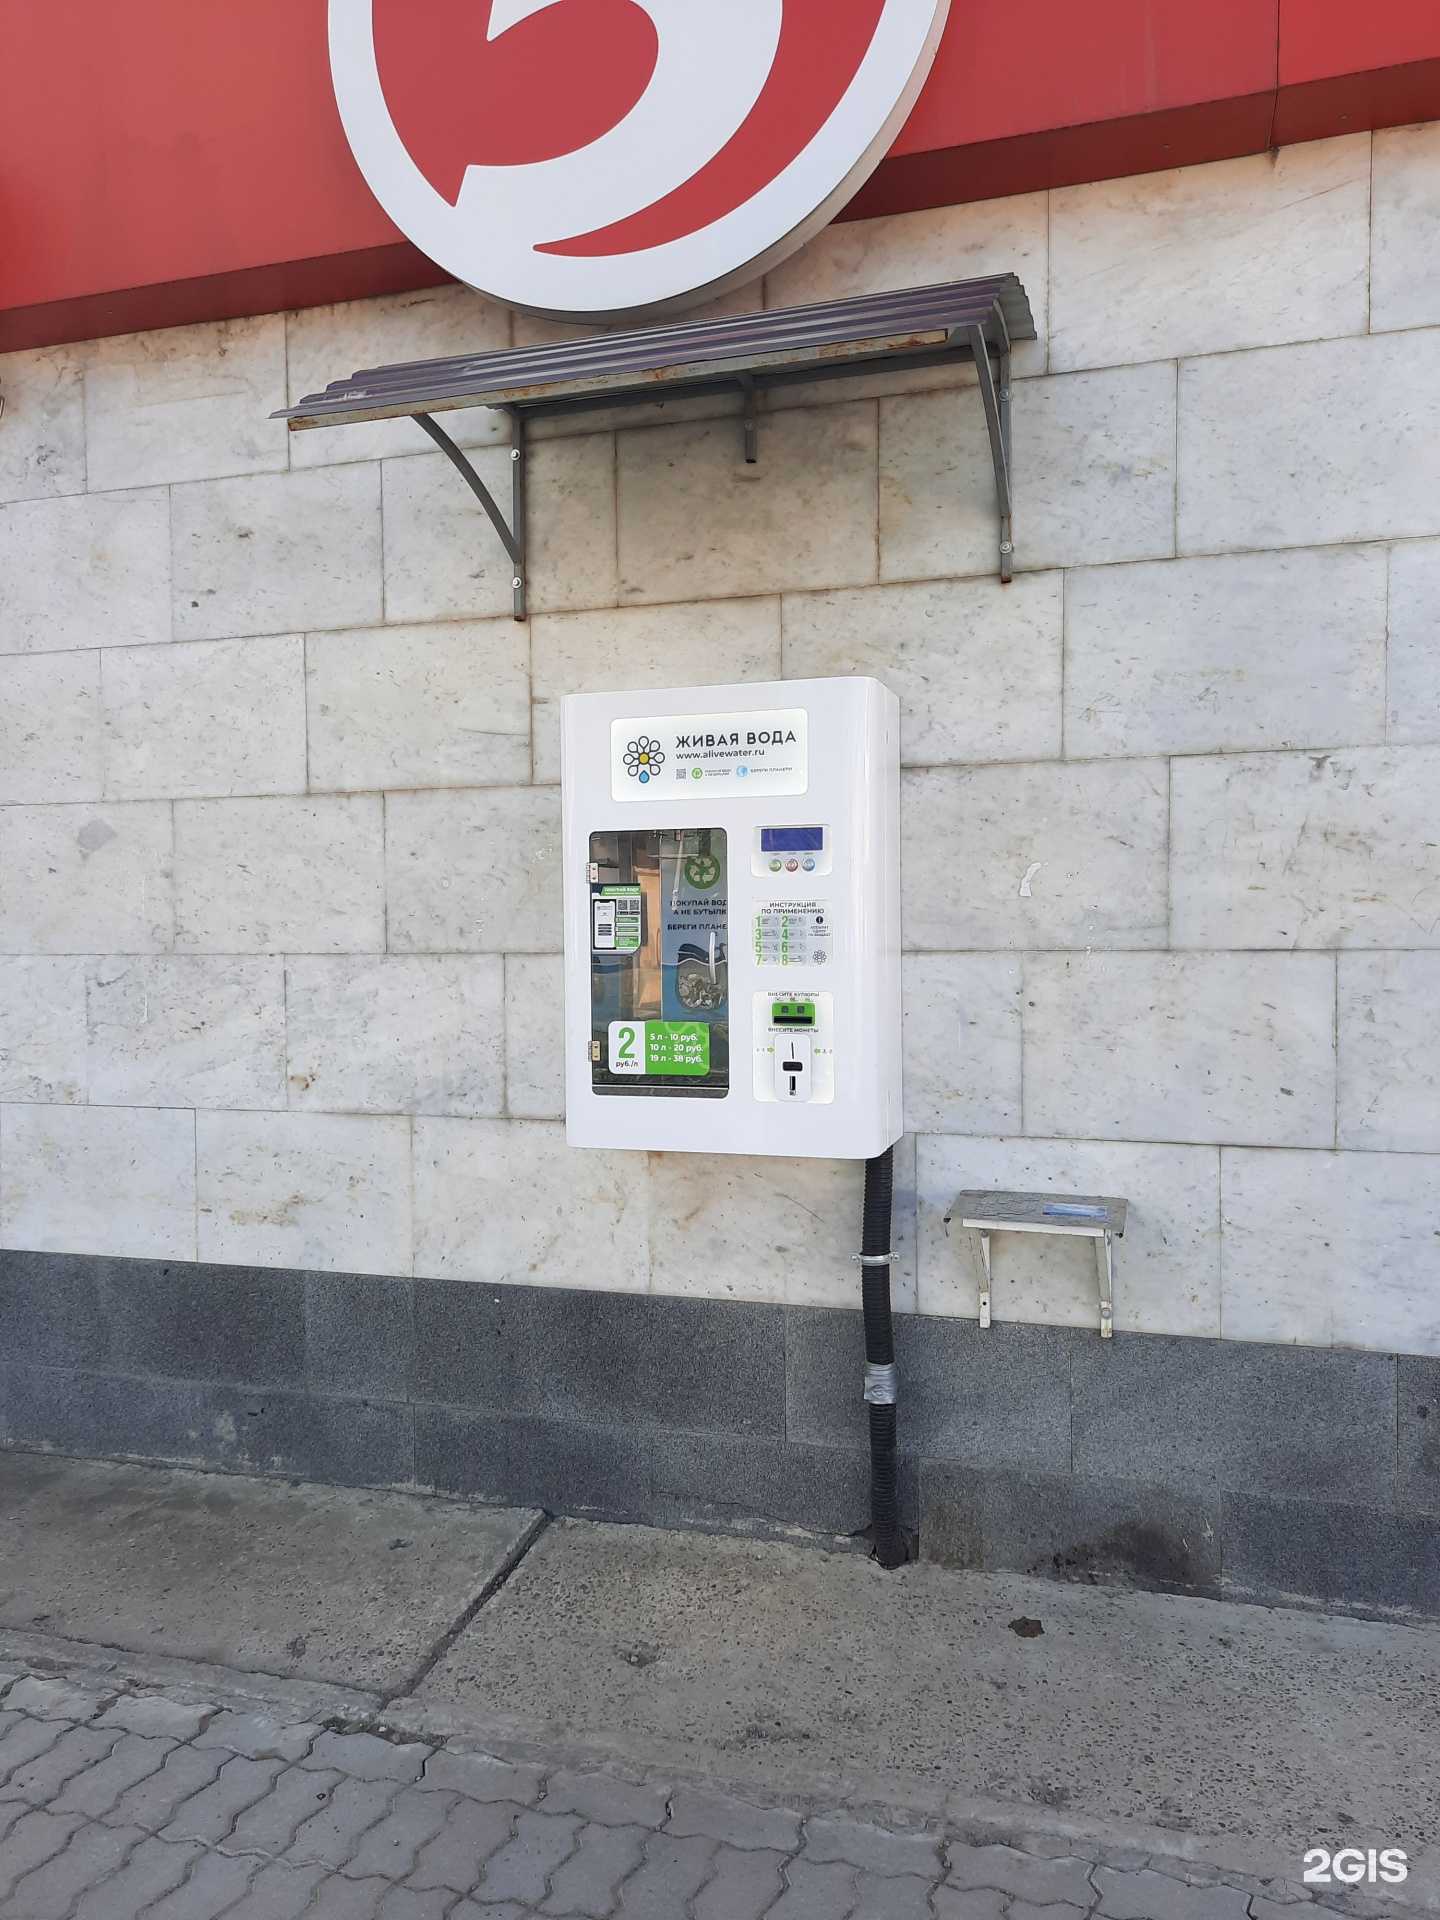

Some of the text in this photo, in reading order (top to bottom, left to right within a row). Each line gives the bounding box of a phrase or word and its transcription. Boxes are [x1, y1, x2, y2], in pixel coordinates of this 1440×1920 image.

[675, 730, 796, 748] ЖИВАЯ ВОДА
[676, 748, 765, 759] www.alivewater.ru
[618, 1027, 635, 1058] 2
[681, 1033, 698, 1042] руб.
[686, 1045, 704, 1053] руб.
[686, 1055, 704, 1063] руб.
